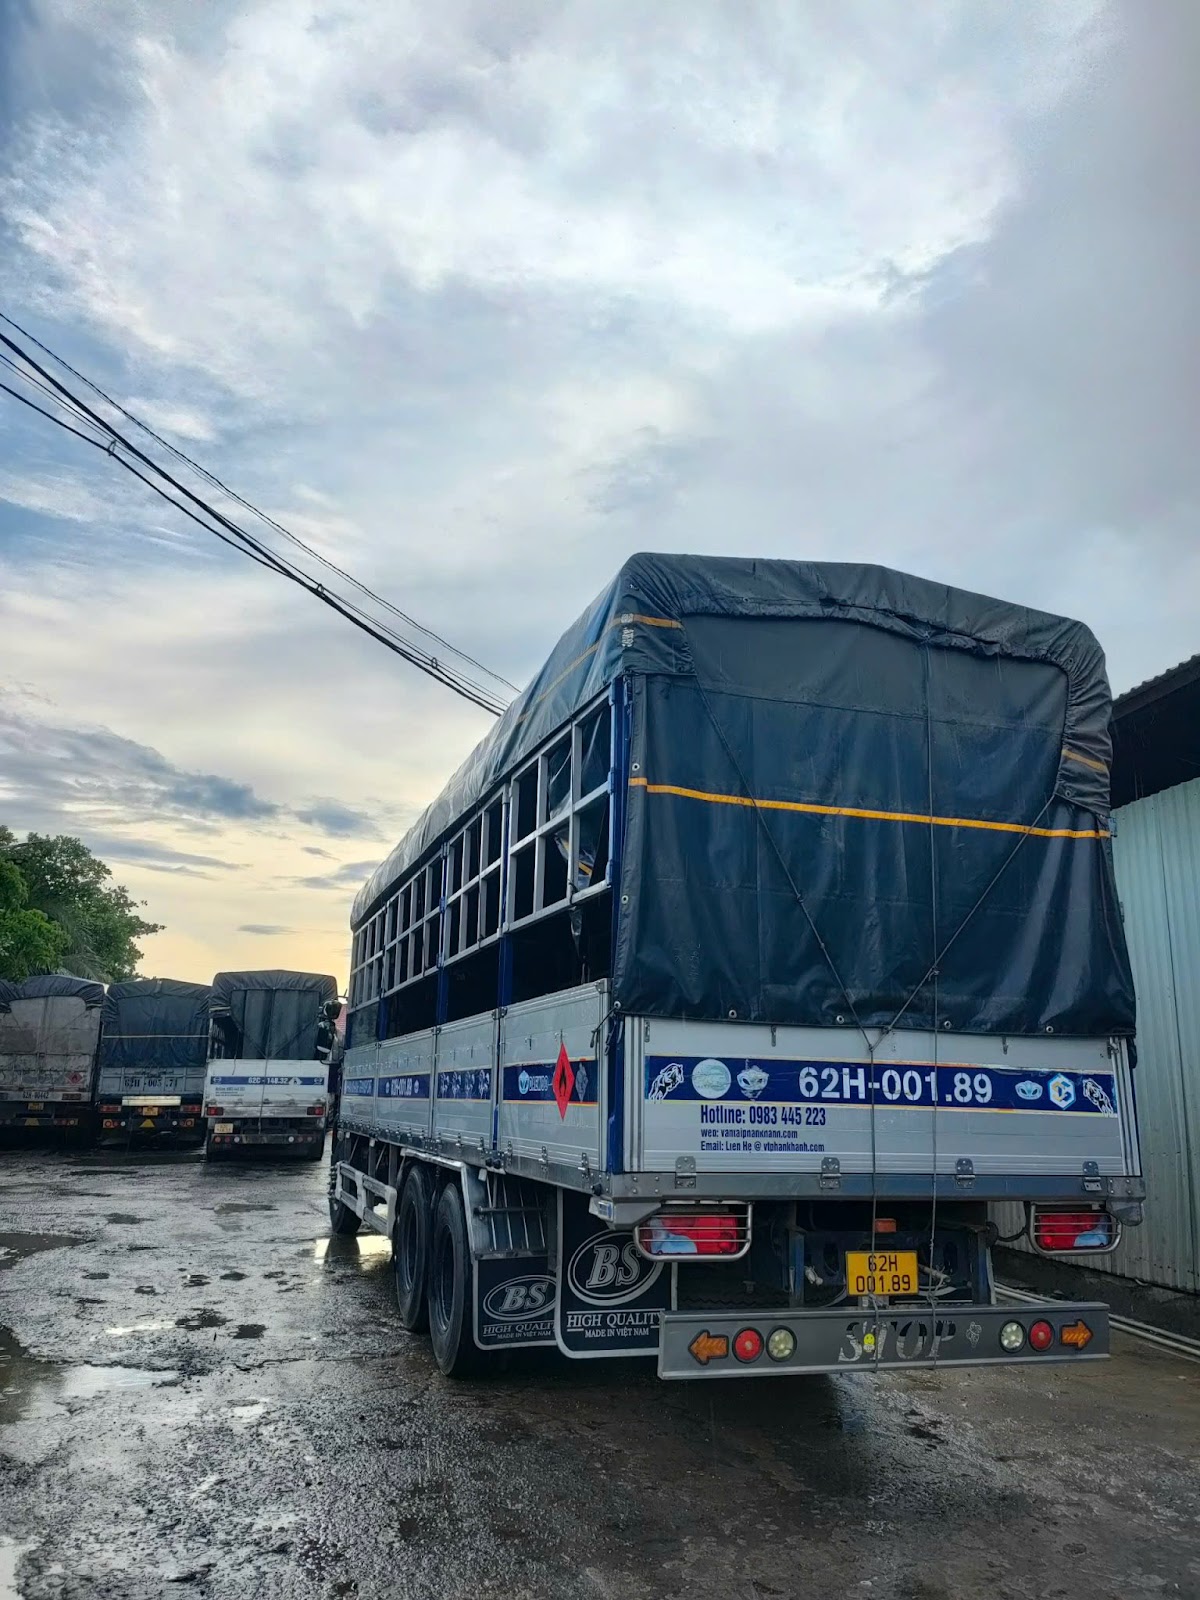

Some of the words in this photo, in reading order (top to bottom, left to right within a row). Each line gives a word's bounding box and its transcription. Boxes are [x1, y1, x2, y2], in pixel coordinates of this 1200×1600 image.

[798, 1066, 993, 1104] 62H-001.89
[700, 1105, 746, 1124] Hotline:
[749, 1106, 777, 1125] 0983
[781, 1106, 802, 1126] 445
[805, 1107, 826, 1126] 223
[700, 1140, 724, 1152] Email:
[754, 1141, 762, 1152] @
[586, 1241, 642, 1289] BS
[868, 1254, 898, 1272] 62H
[856, 1274, 911, 1293] 001.89
[499, 1282, 549, 1312] BS
[483, 1324, 512, 1335] HIGH
[566, 1314, 602, 1328] HIGH
[585, 1329, 606, 1338] MADE
[606, 1329, 615, 1337] IN
[633, 1327, 650, 1336] NAM
